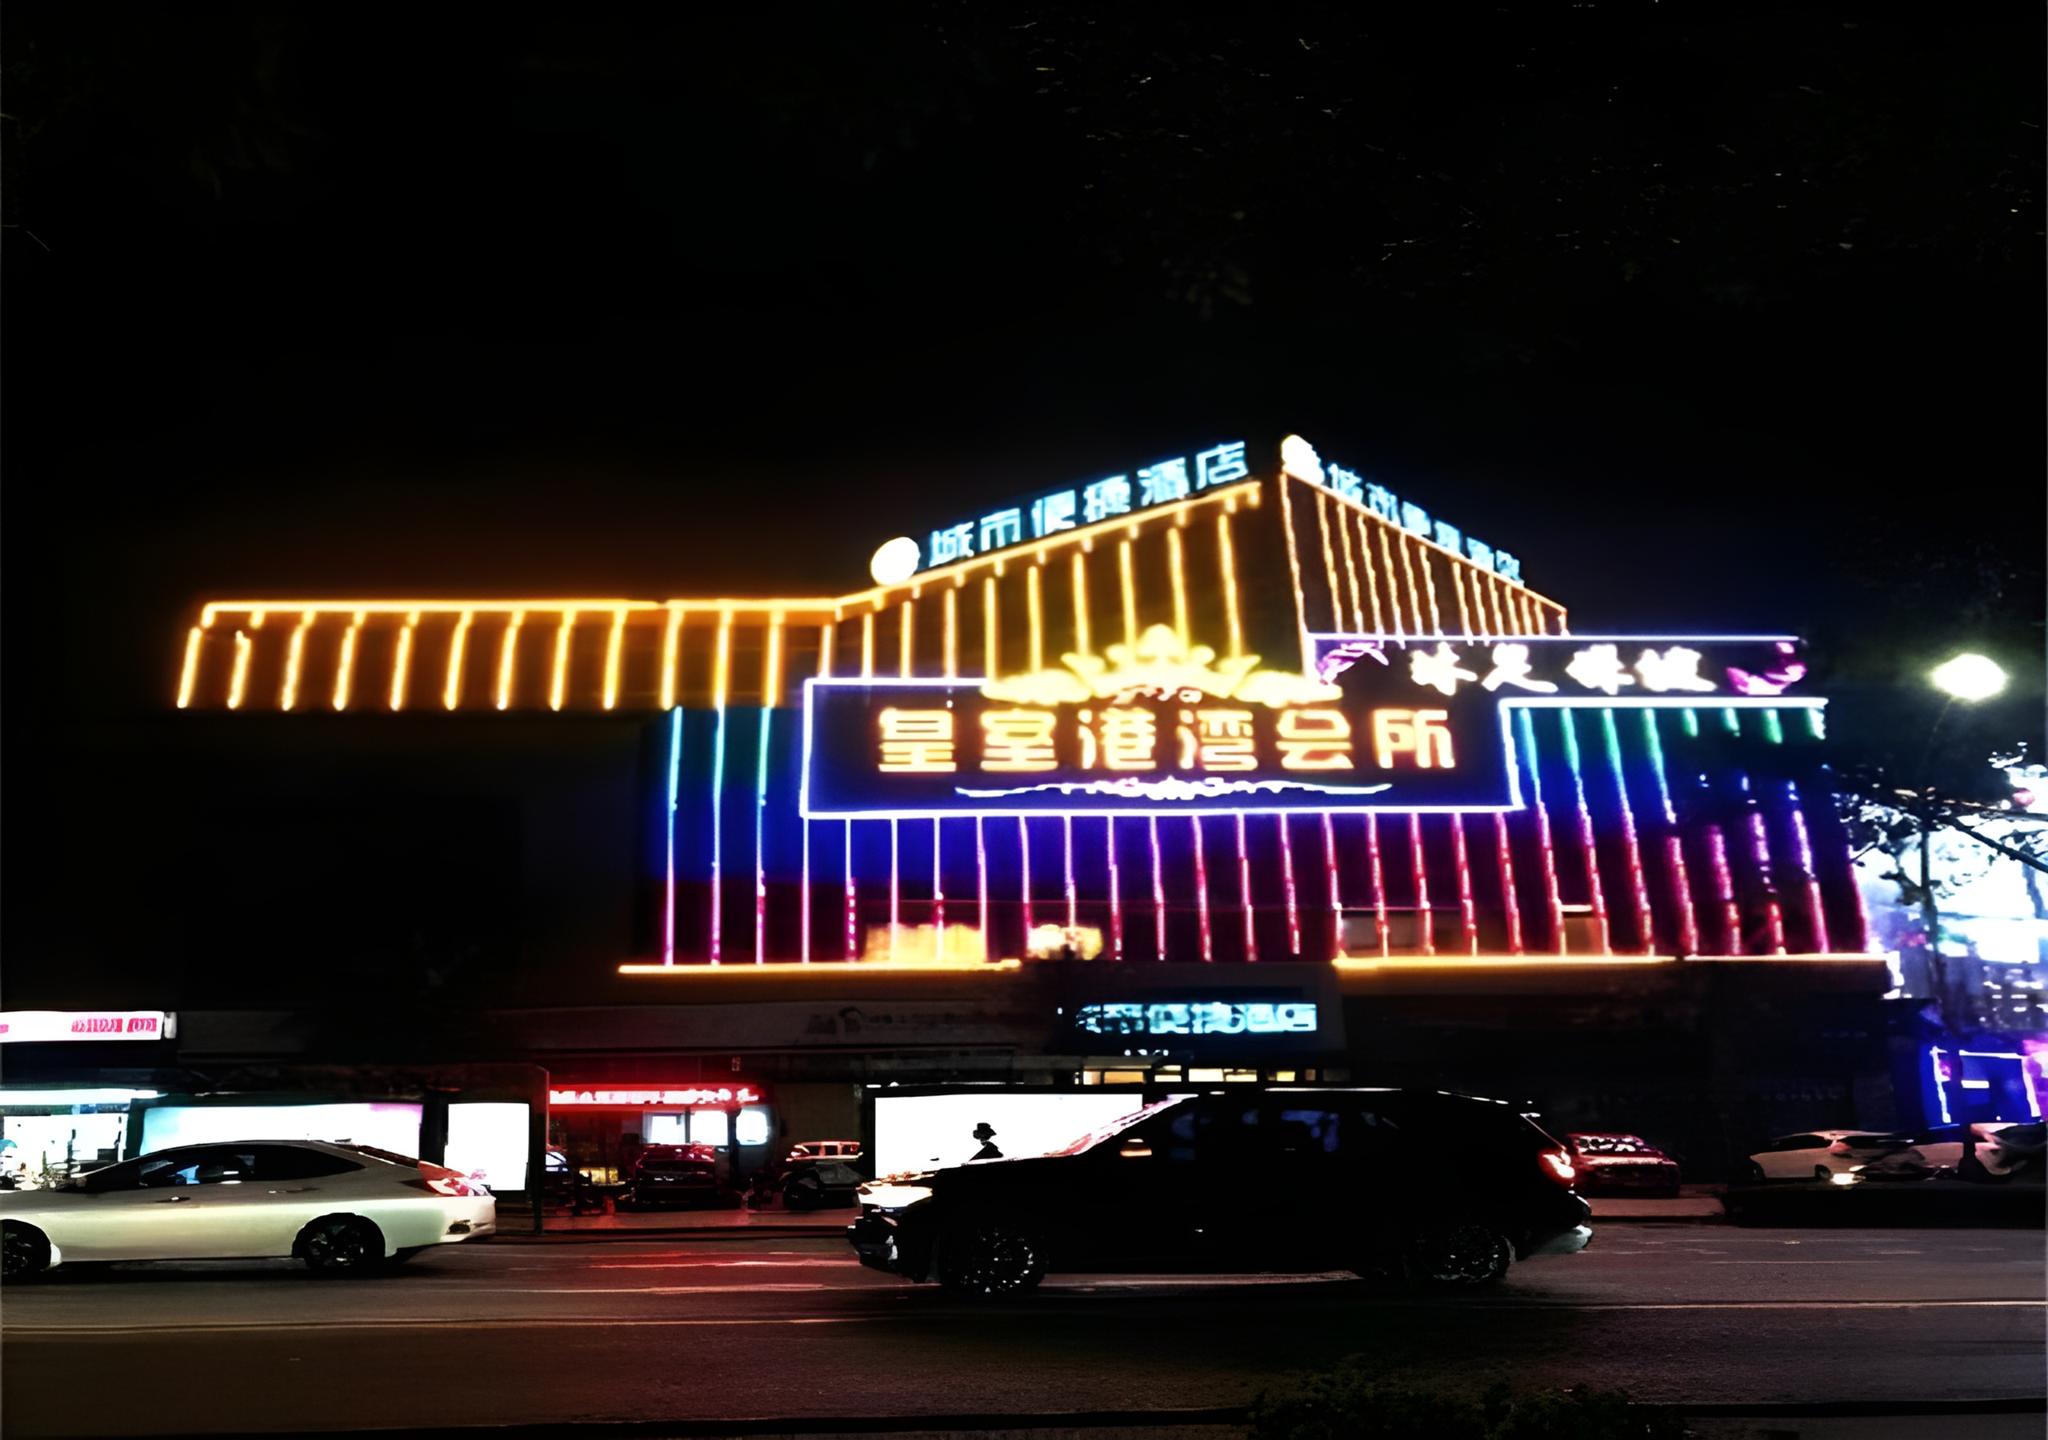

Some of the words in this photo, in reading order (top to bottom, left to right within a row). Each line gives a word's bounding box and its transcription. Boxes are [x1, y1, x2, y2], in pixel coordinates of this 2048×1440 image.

[929, 442, 1248, 567] 城市便捷酒店
[878, 708, 1456, 771] 皇室港湾会所
